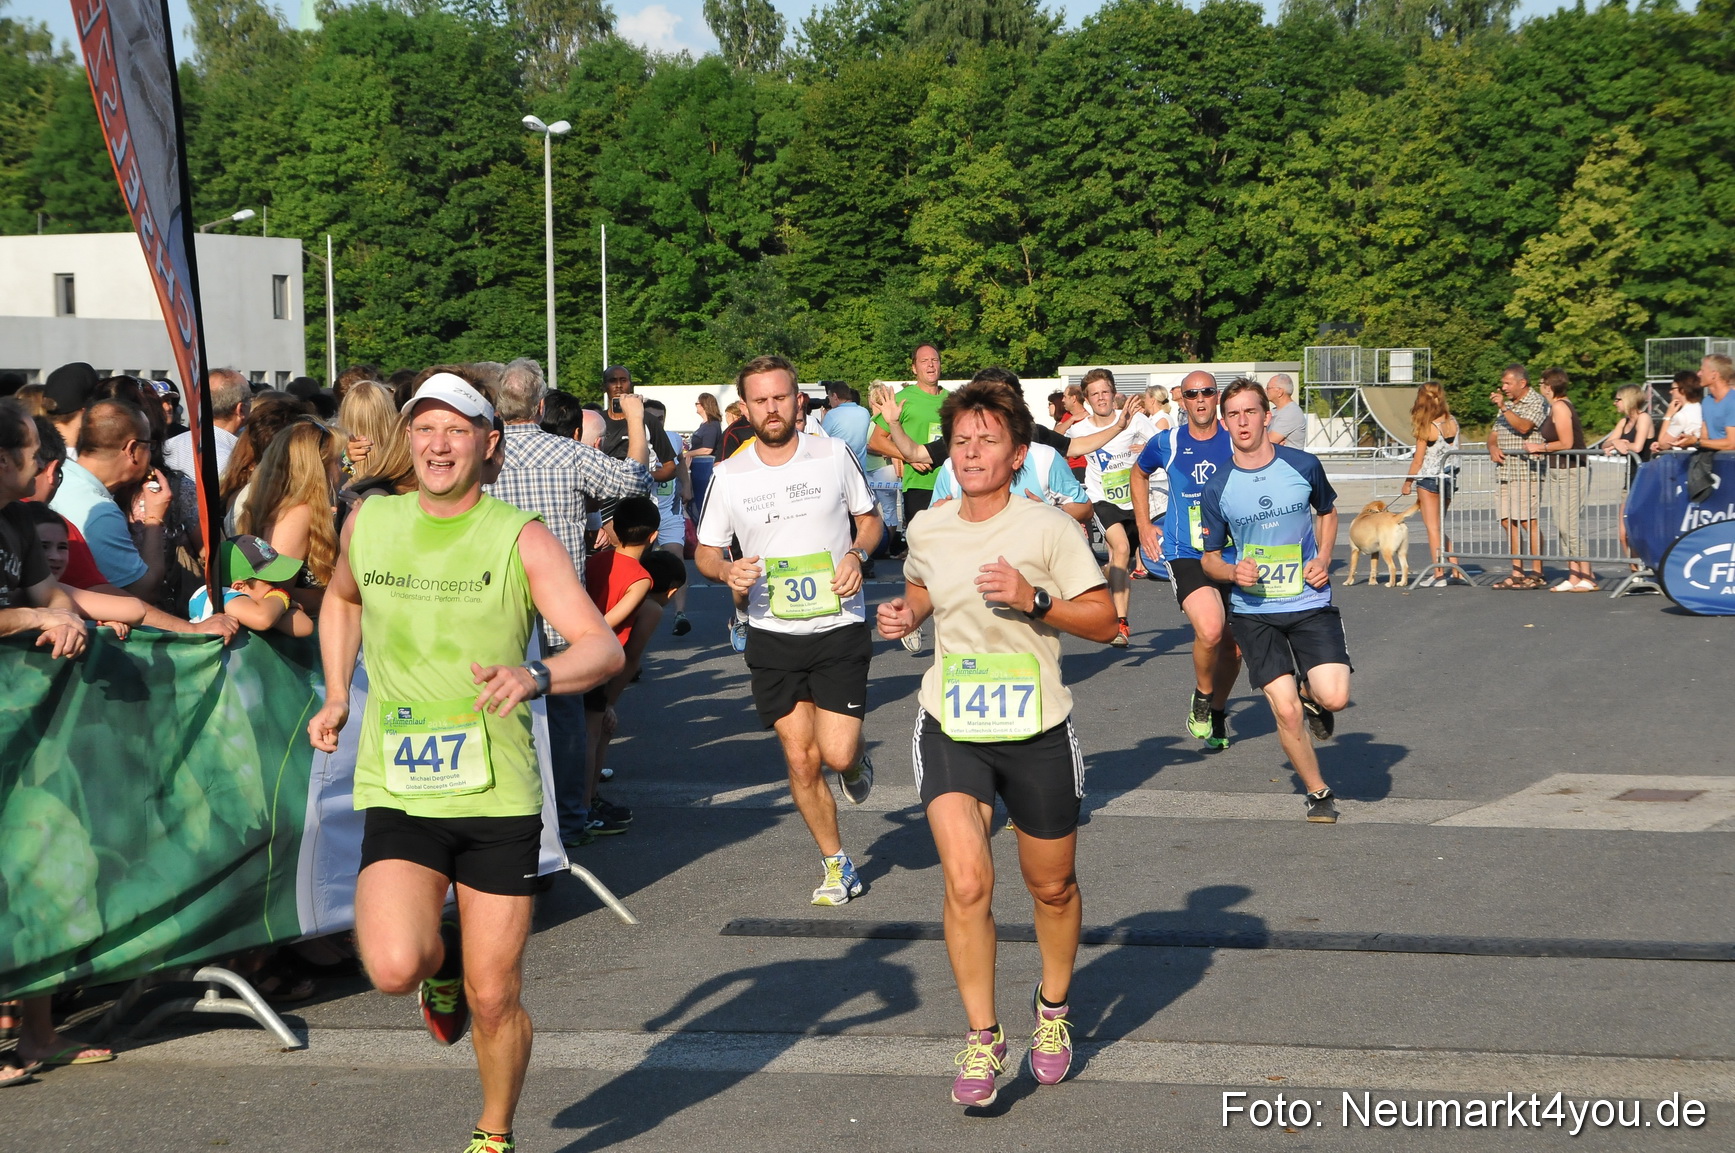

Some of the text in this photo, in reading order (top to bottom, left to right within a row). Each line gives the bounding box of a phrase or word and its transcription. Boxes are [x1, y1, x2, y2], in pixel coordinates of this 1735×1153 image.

[785, 482, 808, 493] HECK
[789, 487, 822, 499] DESIGN
[742, 492, 777, 505] PEUGEOT
[746, 501, 775, 513] MÜLLER
[1235, 502, 1304, 527] SCHABMÜLLER
[1261, 521, 1280, 530] TEAM
[363, 569, 483, 595] globalconcepts
[784, 576, 817, 603] 30
[390, 591, 432, 602] Understand.
[463, 595, 483, 604] Care.
[945, 684, 1035, 719] 1417
[392, 717, 426, 726] firmenlauf
[394, 732, 467, 773] 447
[410, 773, 460, 782] Michael Degroute
[423, 782, 448, 791] Concepts
